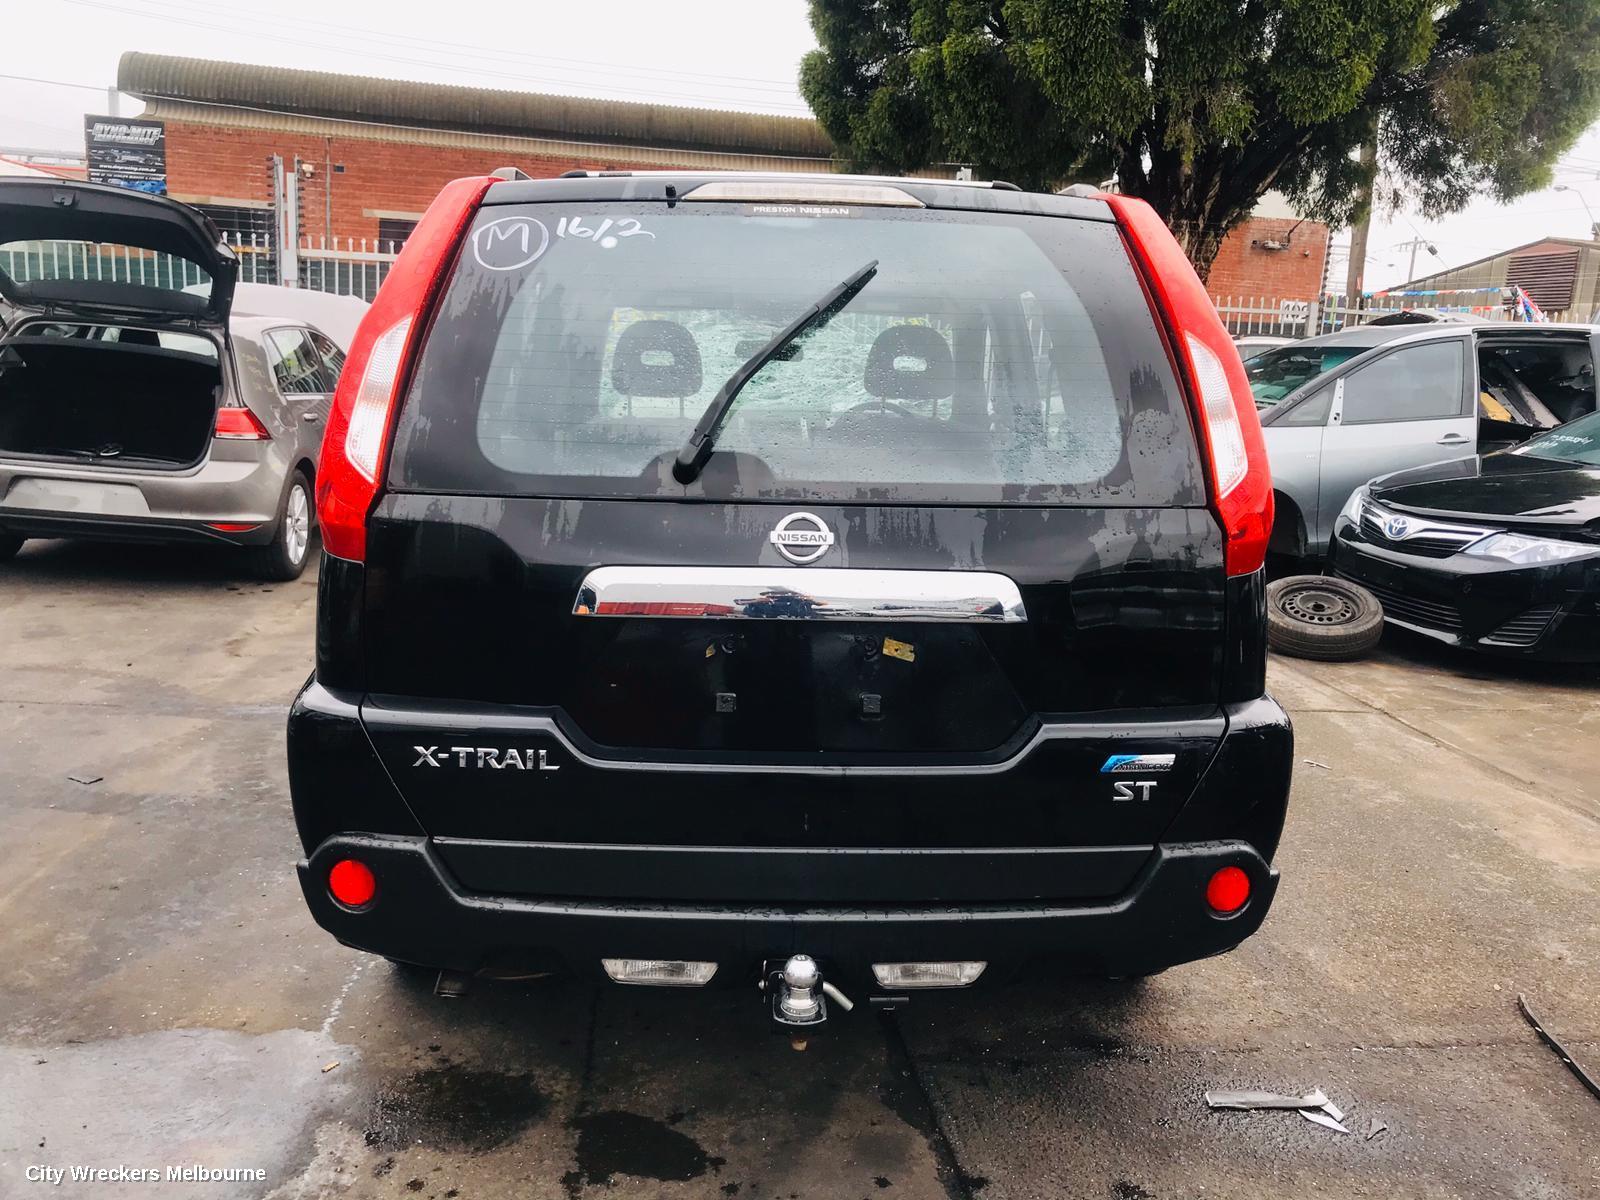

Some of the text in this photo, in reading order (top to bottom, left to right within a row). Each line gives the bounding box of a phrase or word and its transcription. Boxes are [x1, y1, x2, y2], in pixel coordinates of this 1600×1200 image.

[800, 207, 849, 215] NISSAN
[777, 533, 827, 542] NISSAN
[412, 746, 560, 770] X-TRAIL
[1113, 781, 1158, 801] ST
